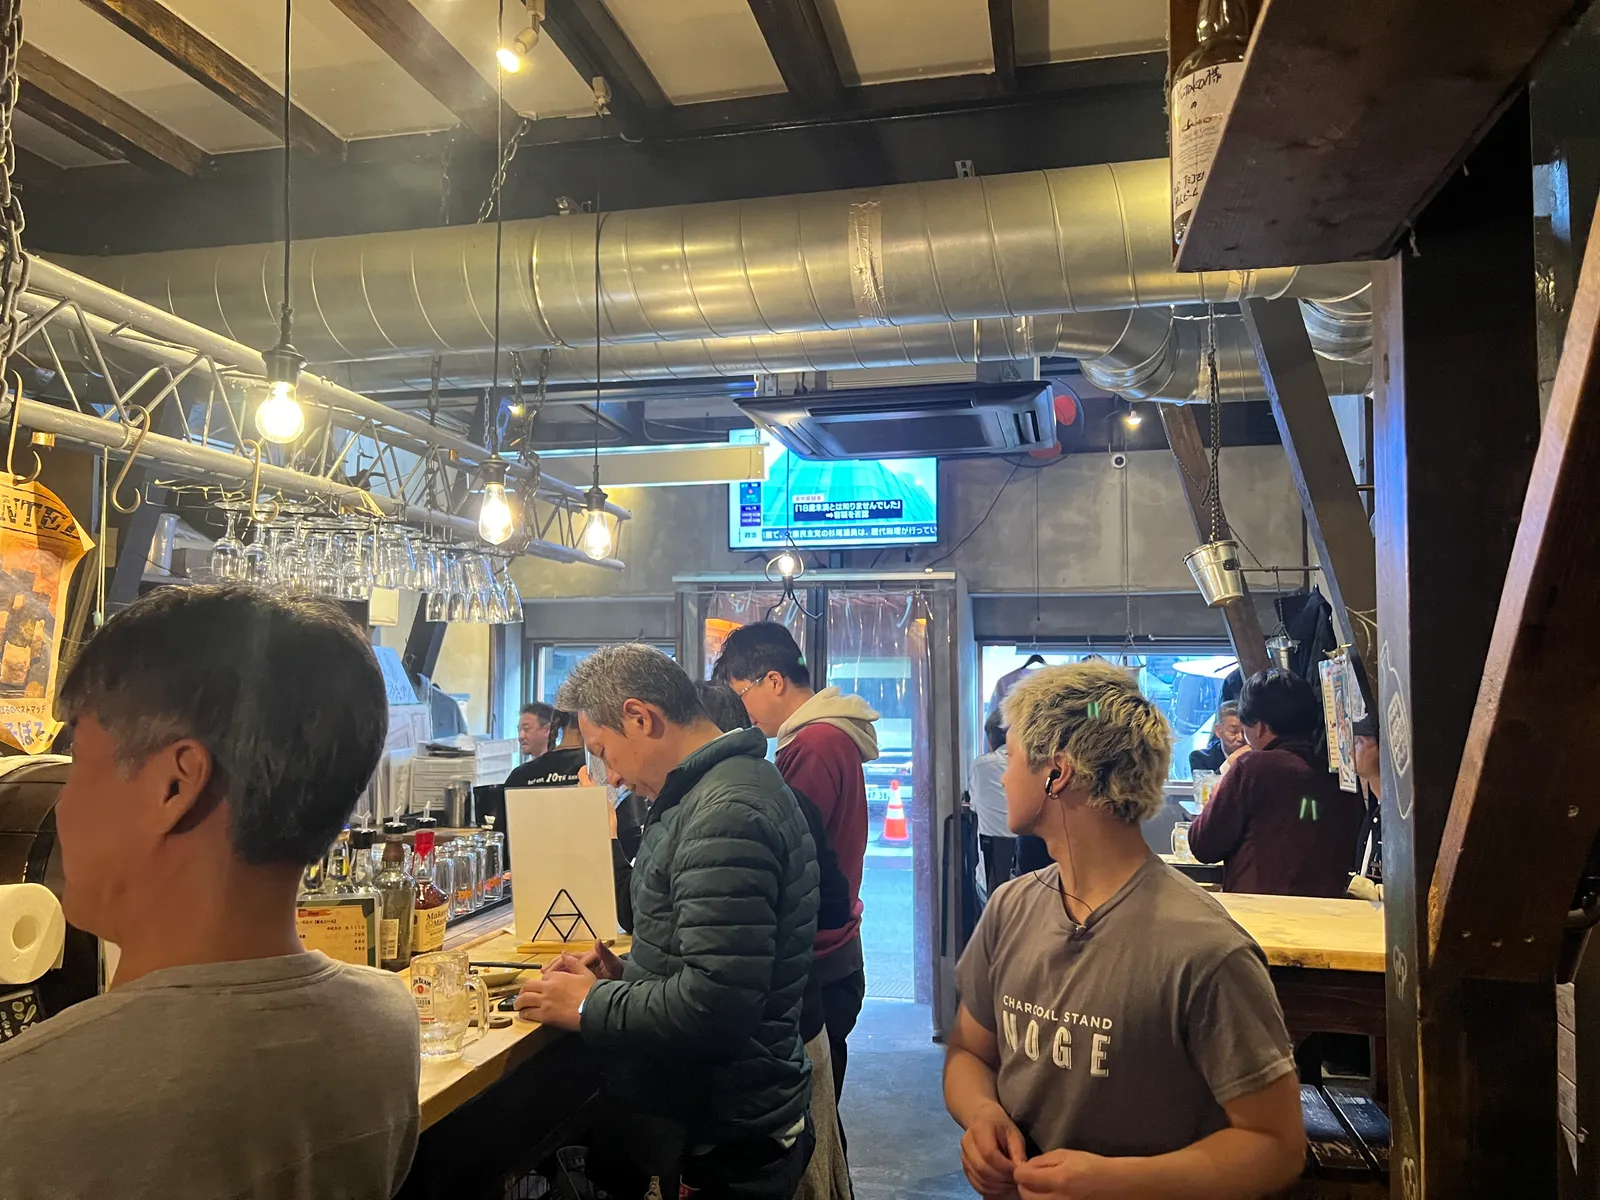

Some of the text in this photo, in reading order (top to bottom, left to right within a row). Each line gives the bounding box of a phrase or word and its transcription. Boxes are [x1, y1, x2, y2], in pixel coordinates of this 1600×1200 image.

[418, 977, 431, 988] BEAM
[1003, 994, 1113, 1030] CHARCOAL STAND
[1002, 1010, 1111, 1077] NOGE
